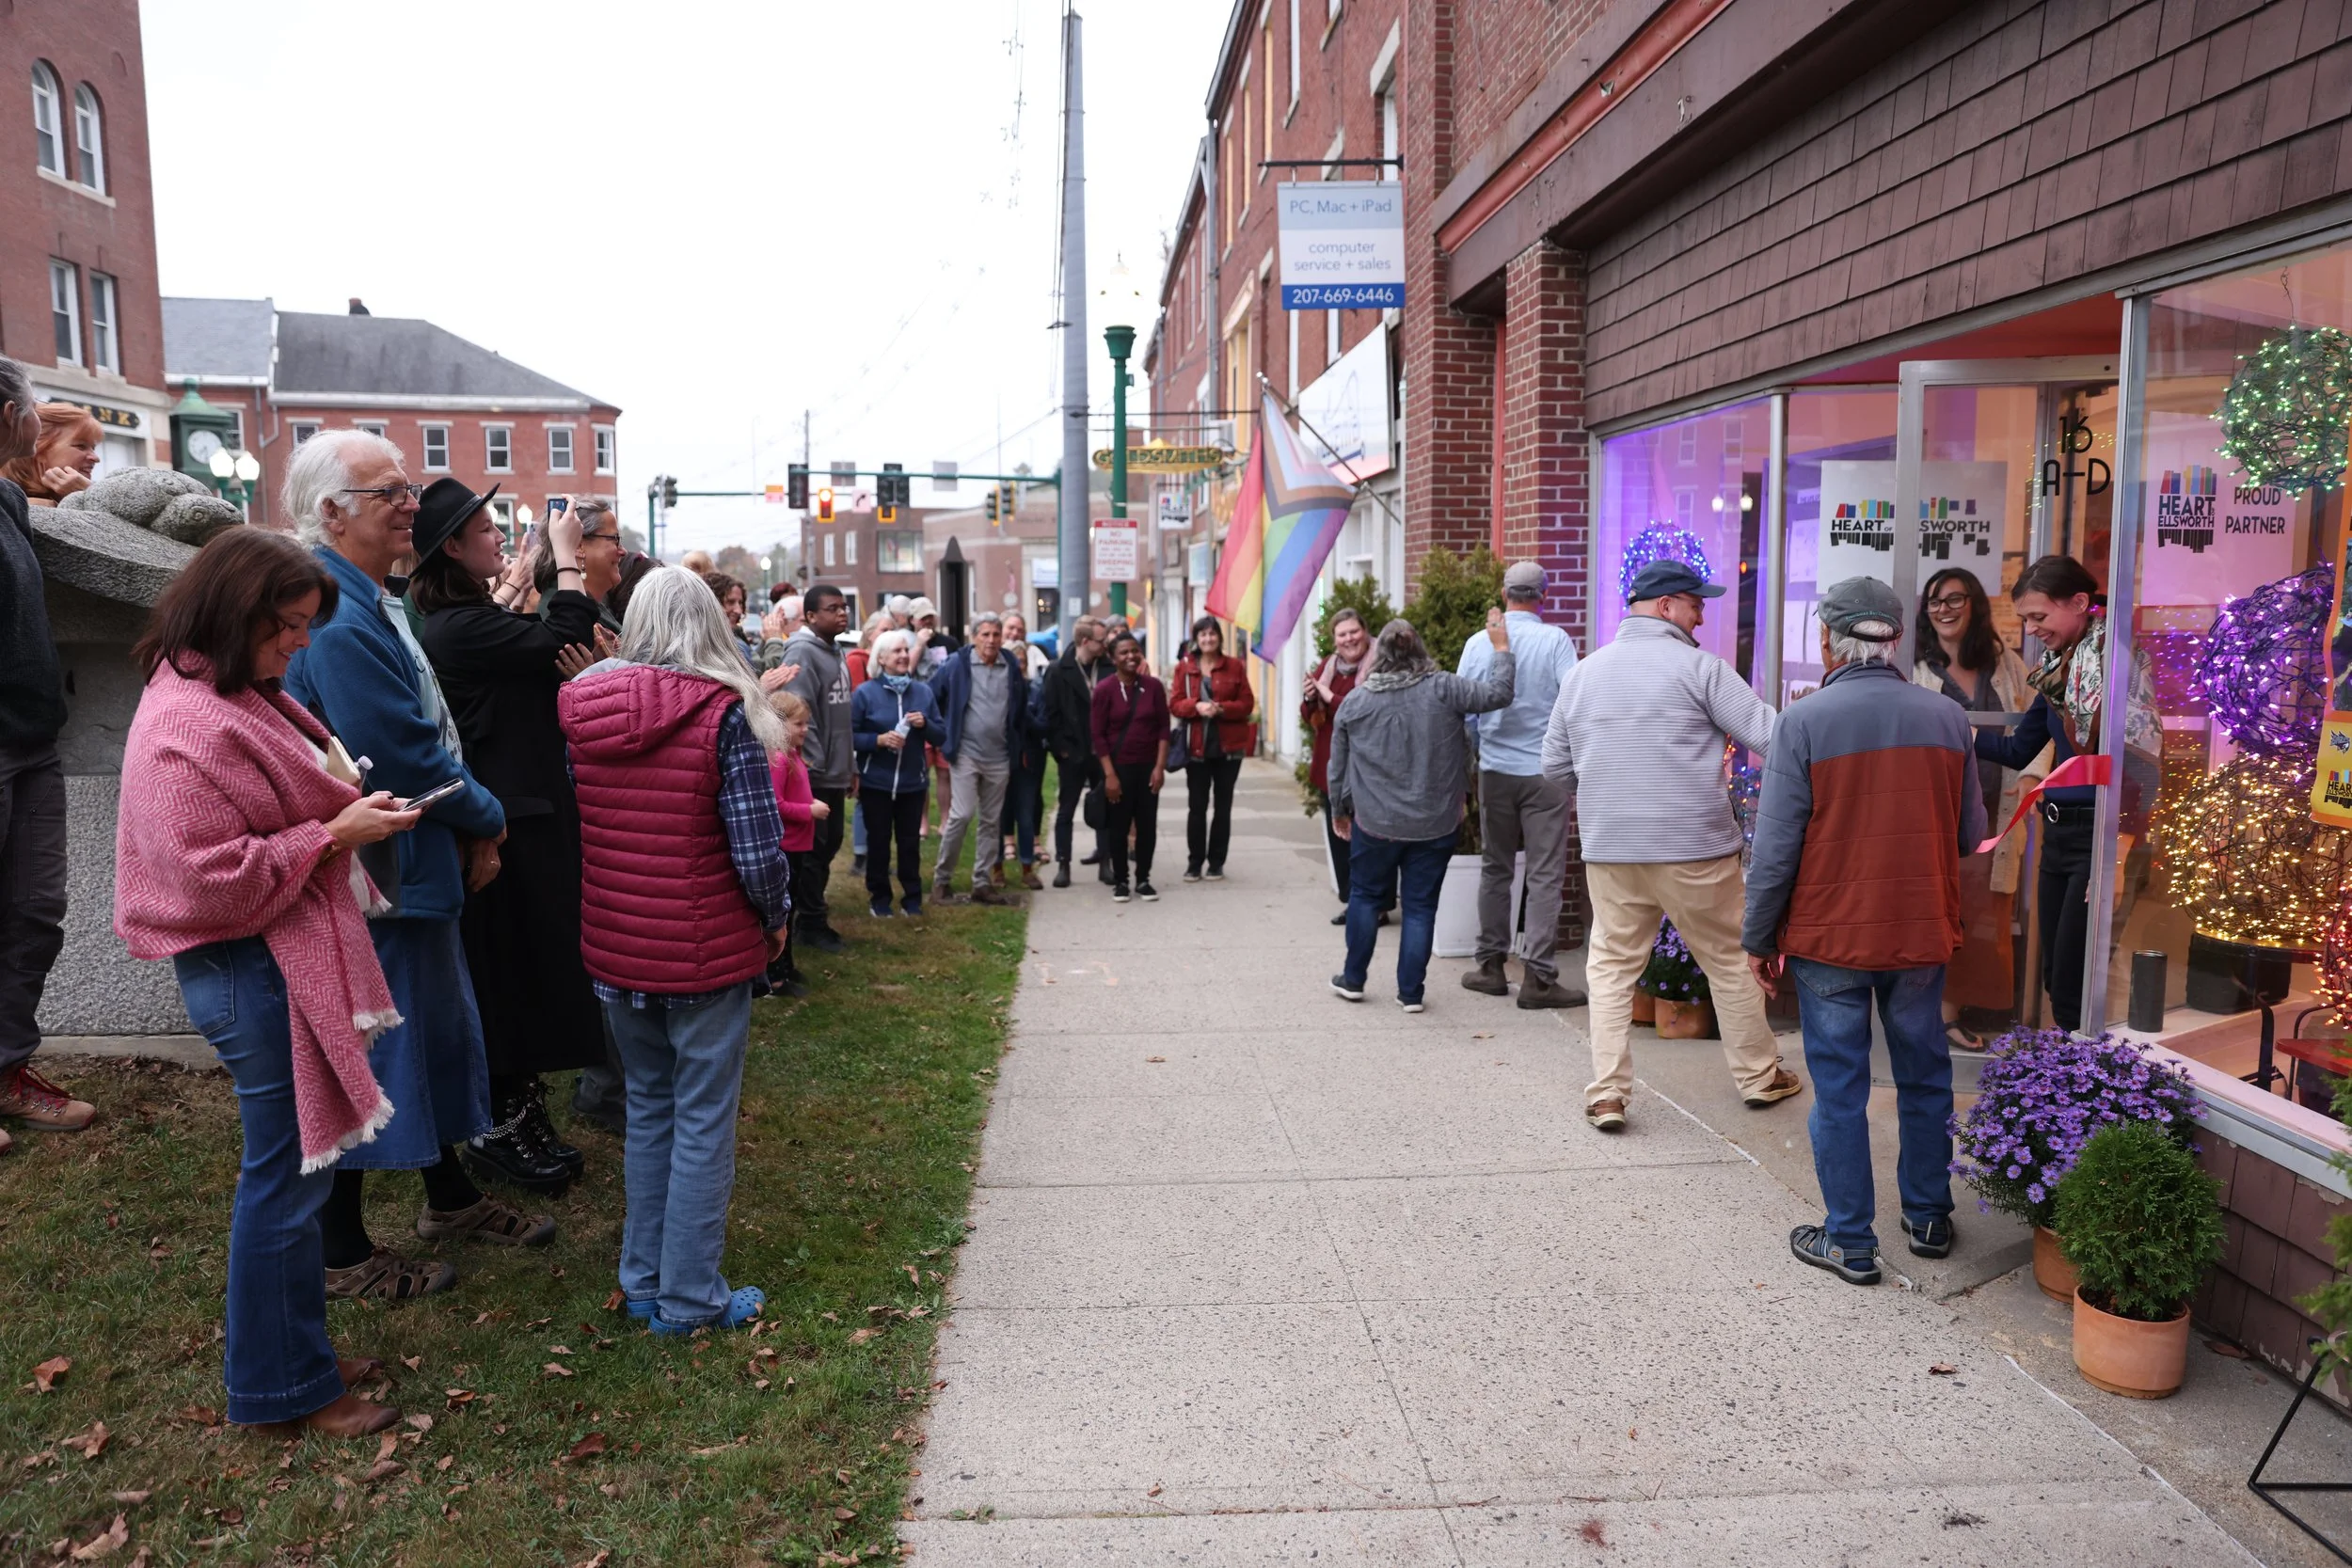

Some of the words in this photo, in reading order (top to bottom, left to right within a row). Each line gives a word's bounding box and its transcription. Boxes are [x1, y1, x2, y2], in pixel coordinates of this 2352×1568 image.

[1290, 199, 1313, 214] PC,
[1317, 199, 1346, 214] Mac
[1350, 202, 1359, 212] +
[1362, 198, 1391, 213] iPad
[1309, 243, 1375, 257] computer
[1294, 259, 1341, 271] service
[1345, 260, 1354, 269] +
[1358, 256, 1391, 270] sales
[1293, 288, 1394, 304] 207-669-6446
[2058, 416, 2093, 453] 16
[2233, 486, 2281, 505] PROUD
[2158, 496, 2216, 515] HEART
[1832, 519, 1884, 531] HEART
[1919, 520, 1991, 532] SWORTH
[2158, 515, 2215, 528] ELLSWORTH
[2225, 515, 2286, 534] PARTNER
